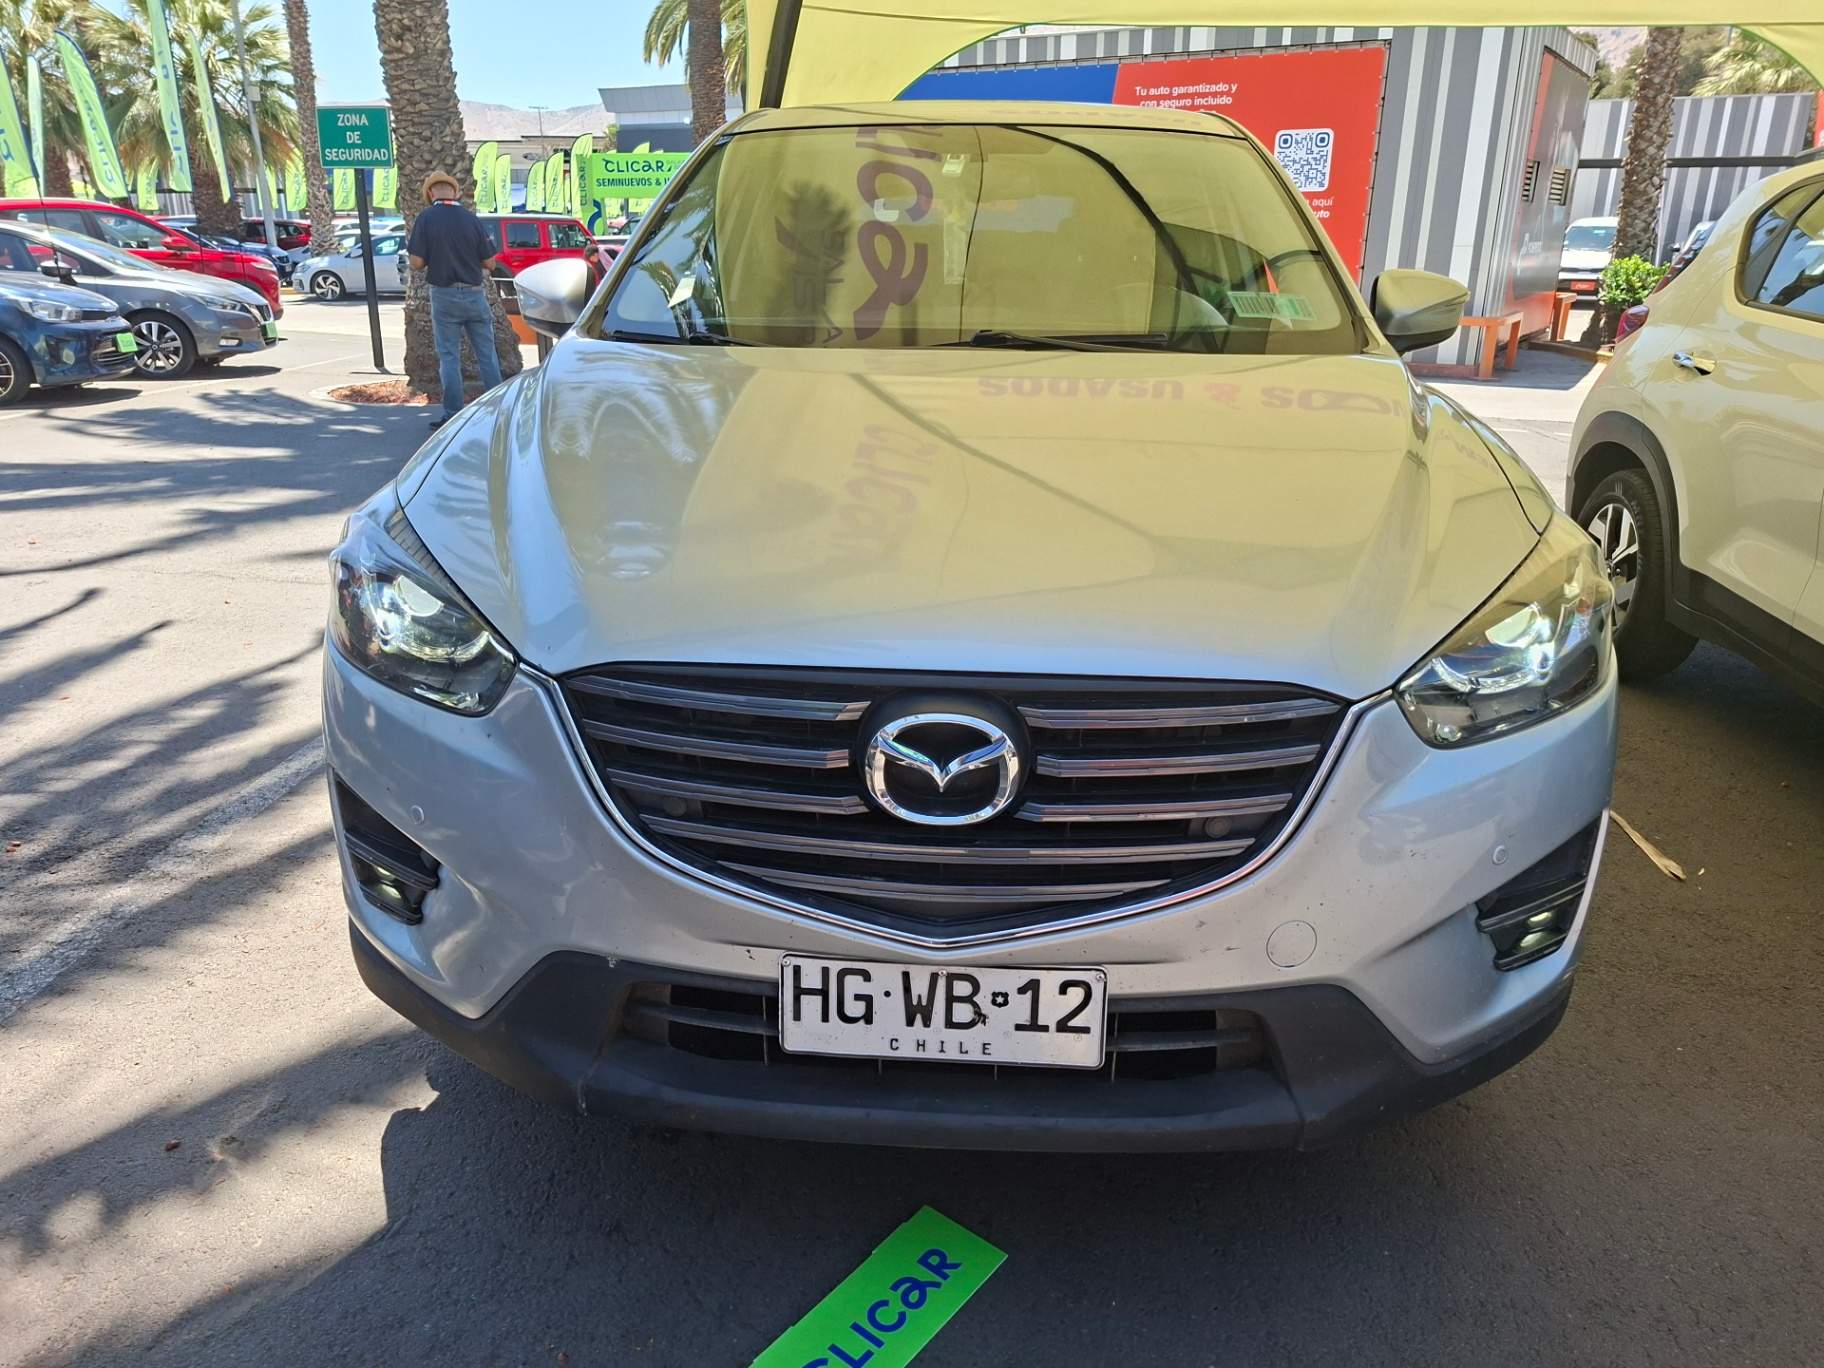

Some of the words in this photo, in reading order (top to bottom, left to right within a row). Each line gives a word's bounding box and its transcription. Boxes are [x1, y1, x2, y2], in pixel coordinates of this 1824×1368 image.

[1135, 86, 1147, 96] Tu
[1149, 86, 1170, 95] auto
[1172, 82, 1229, 96] garantizado
[1231, 83, 1238, 93] y
[1140, 99, 1157, 108] con
[1159, 98, 1192, 109] seguro
[1194, 95, 1233, 106] incluido
[337, 113, 369, 126] ZONA
[346, 131, 362, 144] DE
[325, 148, 389, 161] SEGURIDAD
[596, 177, 652, 187] SEMINUEVOS
[655, 178, 662, 186] &
[1312, 196, 1335, 207] aquí
[1313, 210, 1330, 218] uto
[890, 1037, 992, 1056] CHILE
